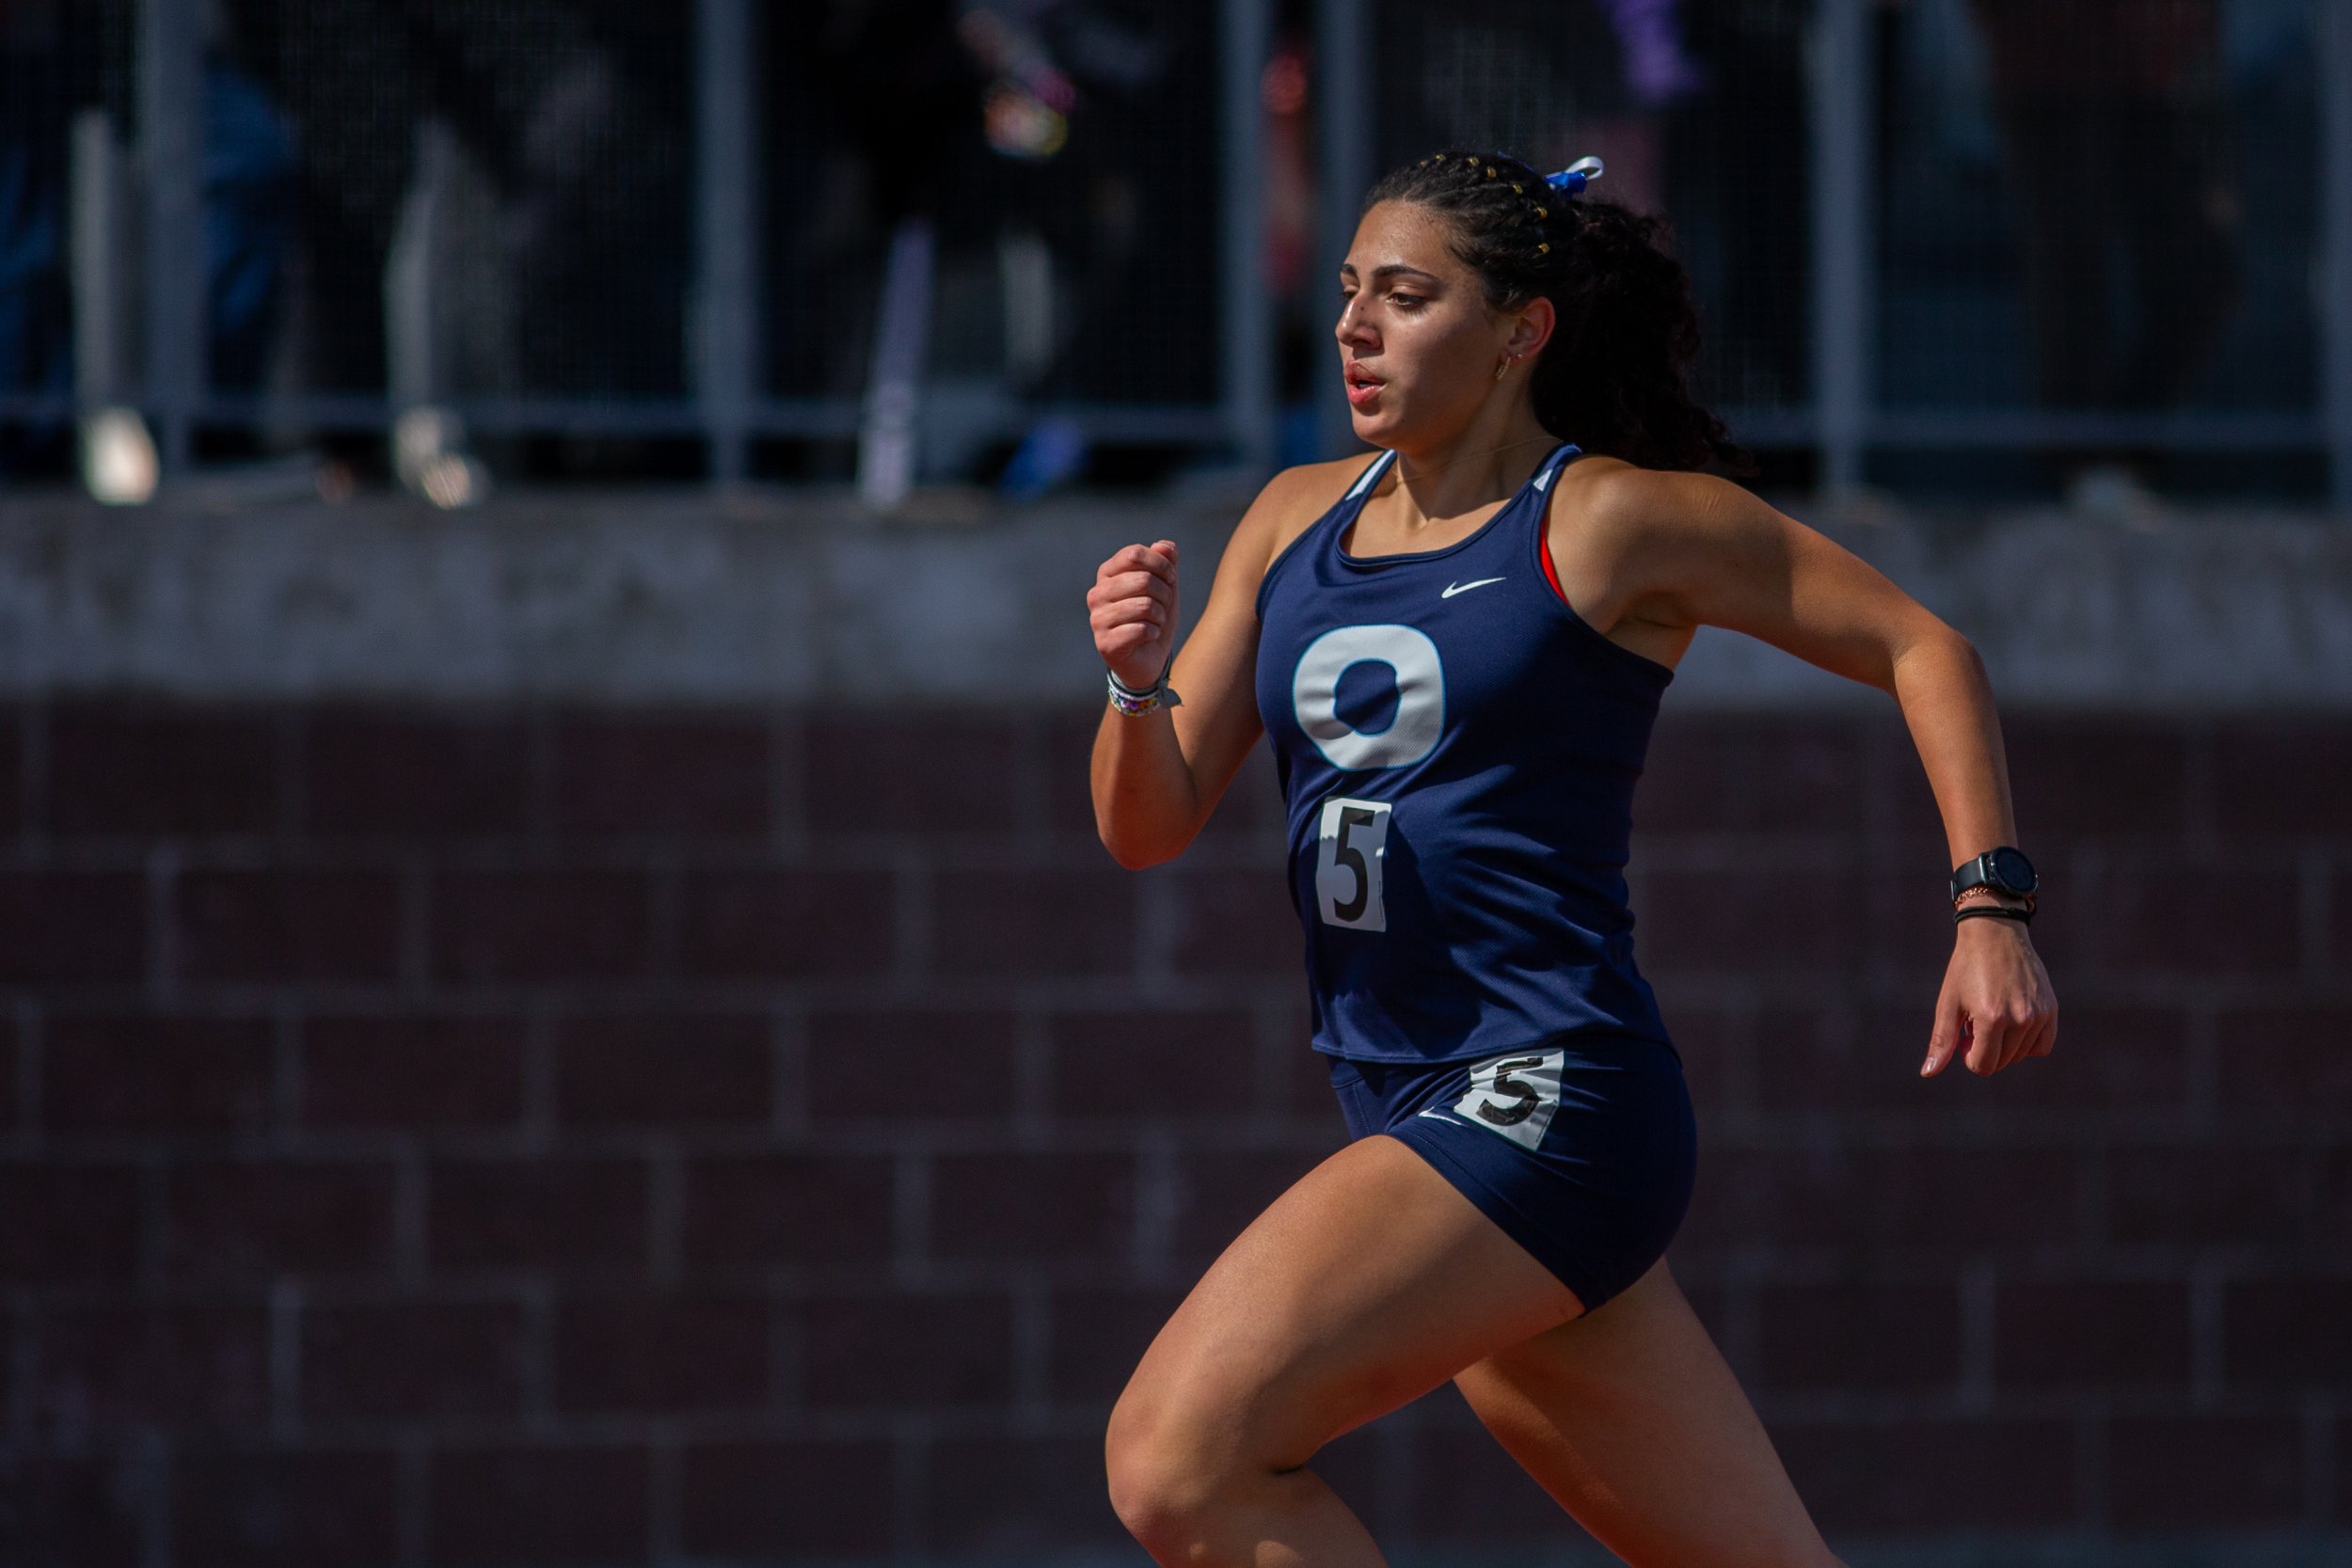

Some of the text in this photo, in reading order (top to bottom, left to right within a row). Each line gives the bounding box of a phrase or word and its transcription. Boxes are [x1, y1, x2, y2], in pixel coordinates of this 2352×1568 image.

[1293, 624, 1445, 770] O
[1333, 806, 1375, 922] 5
[1476, 1057, 1542, 1126] 5
